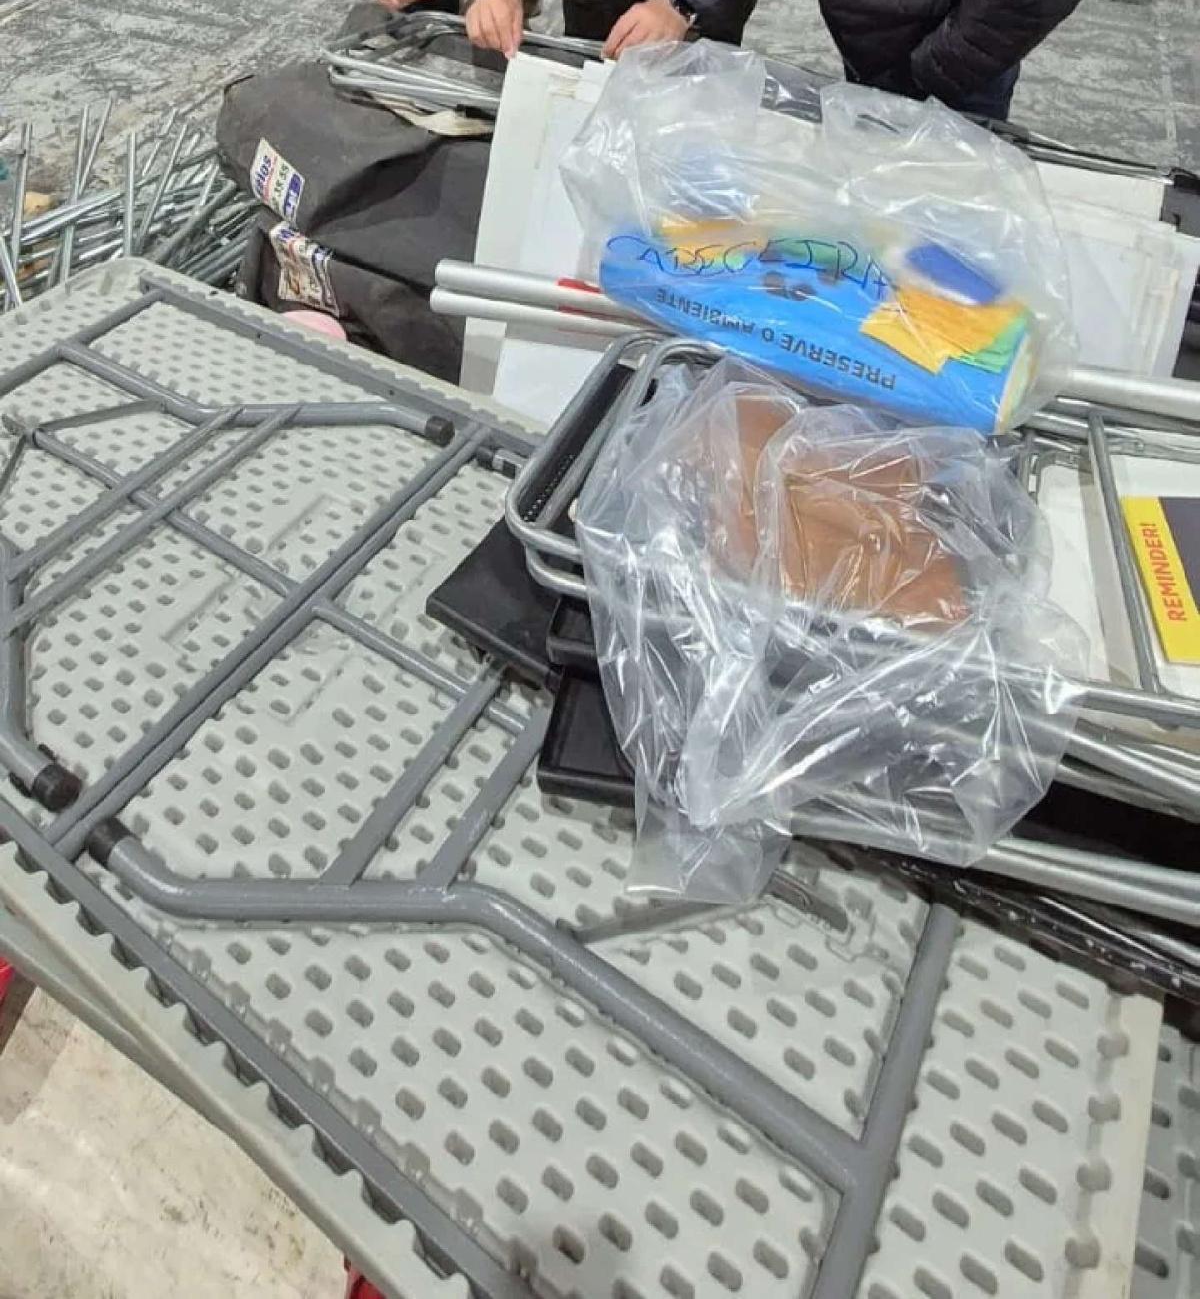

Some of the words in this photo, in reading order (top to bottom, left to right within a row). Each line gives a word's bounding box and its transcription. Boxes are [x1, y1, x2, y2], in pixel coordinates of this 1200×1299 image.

[761, 327, 775, 342] O
[779, 332, 897, 391] PRESERVE
[1138, 521, 1188, 622] REMINDER!
